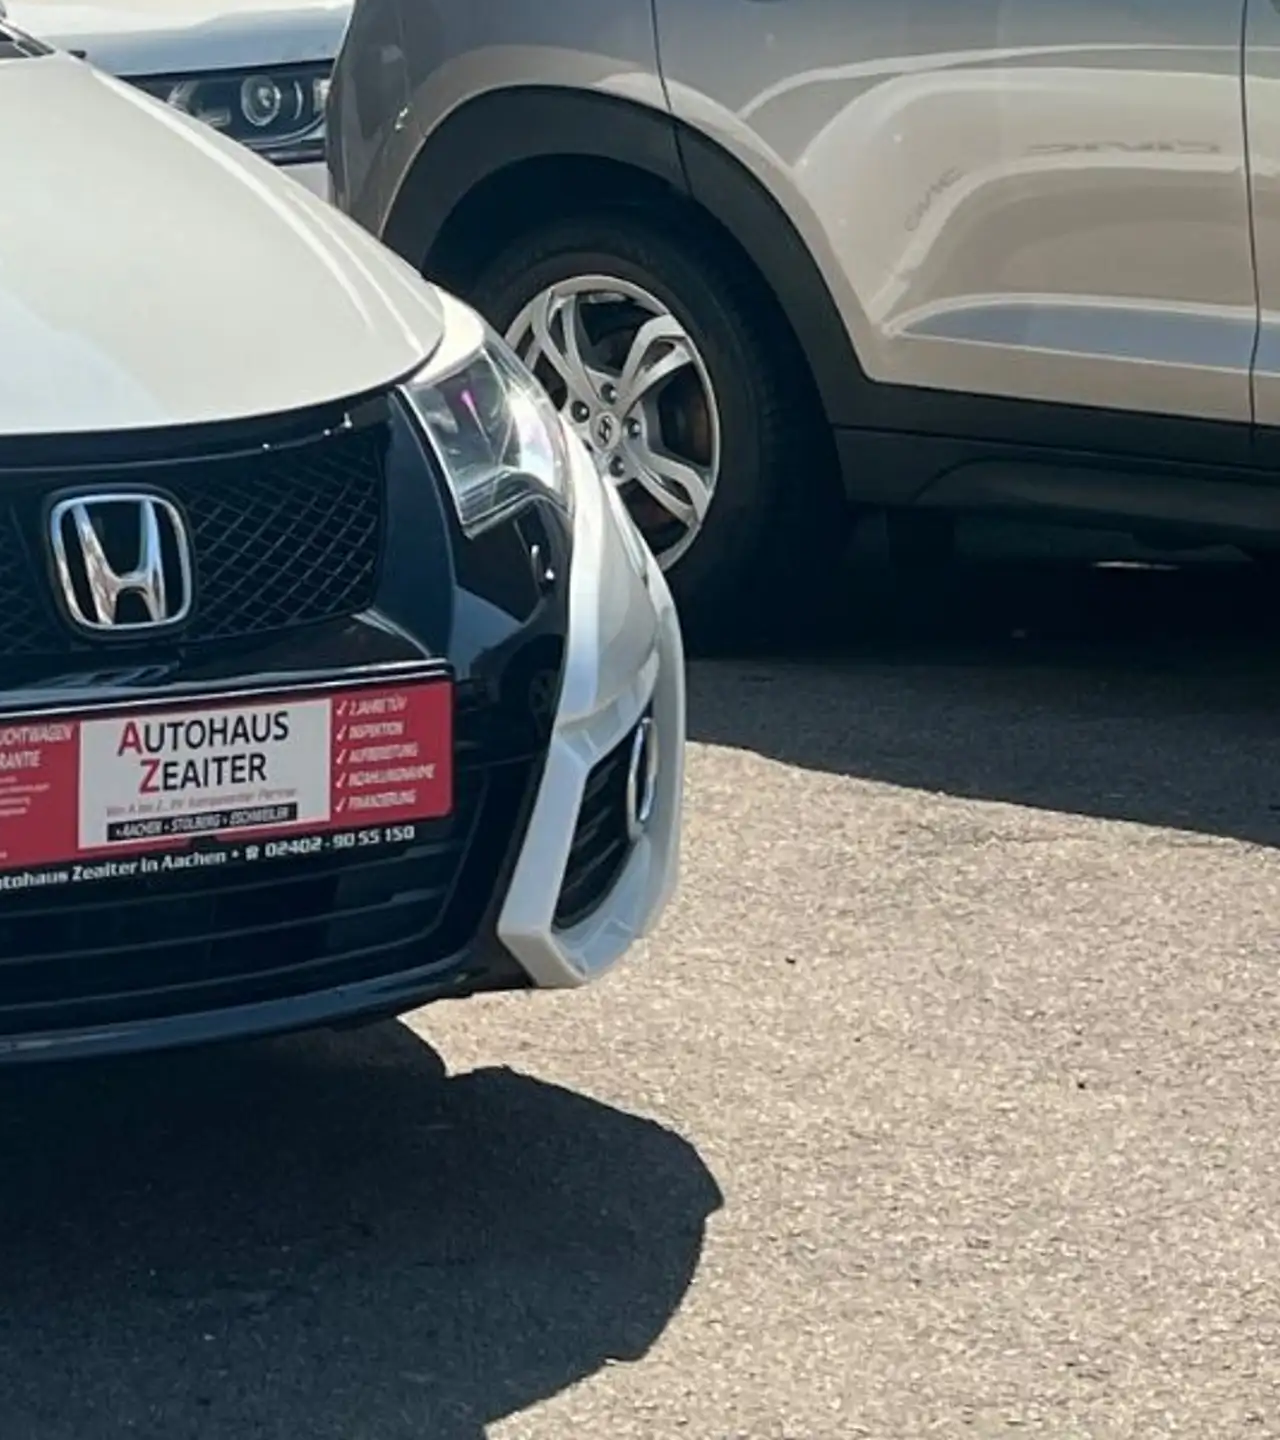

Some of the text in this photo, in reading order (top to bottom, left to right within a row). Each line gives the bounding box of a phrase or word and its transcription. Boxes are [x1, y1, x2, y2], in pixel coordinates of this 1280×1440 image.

[117, 711, 290, 756] AUTOHAUS
[138, 753, 267, 795] ZEAITER
[72, 862, 138, 882] Zeaiter
[161, 849, 226, 871] Aachen
[265, 836, 322, 858] 02402
[384, 825, 416, 843] 150
